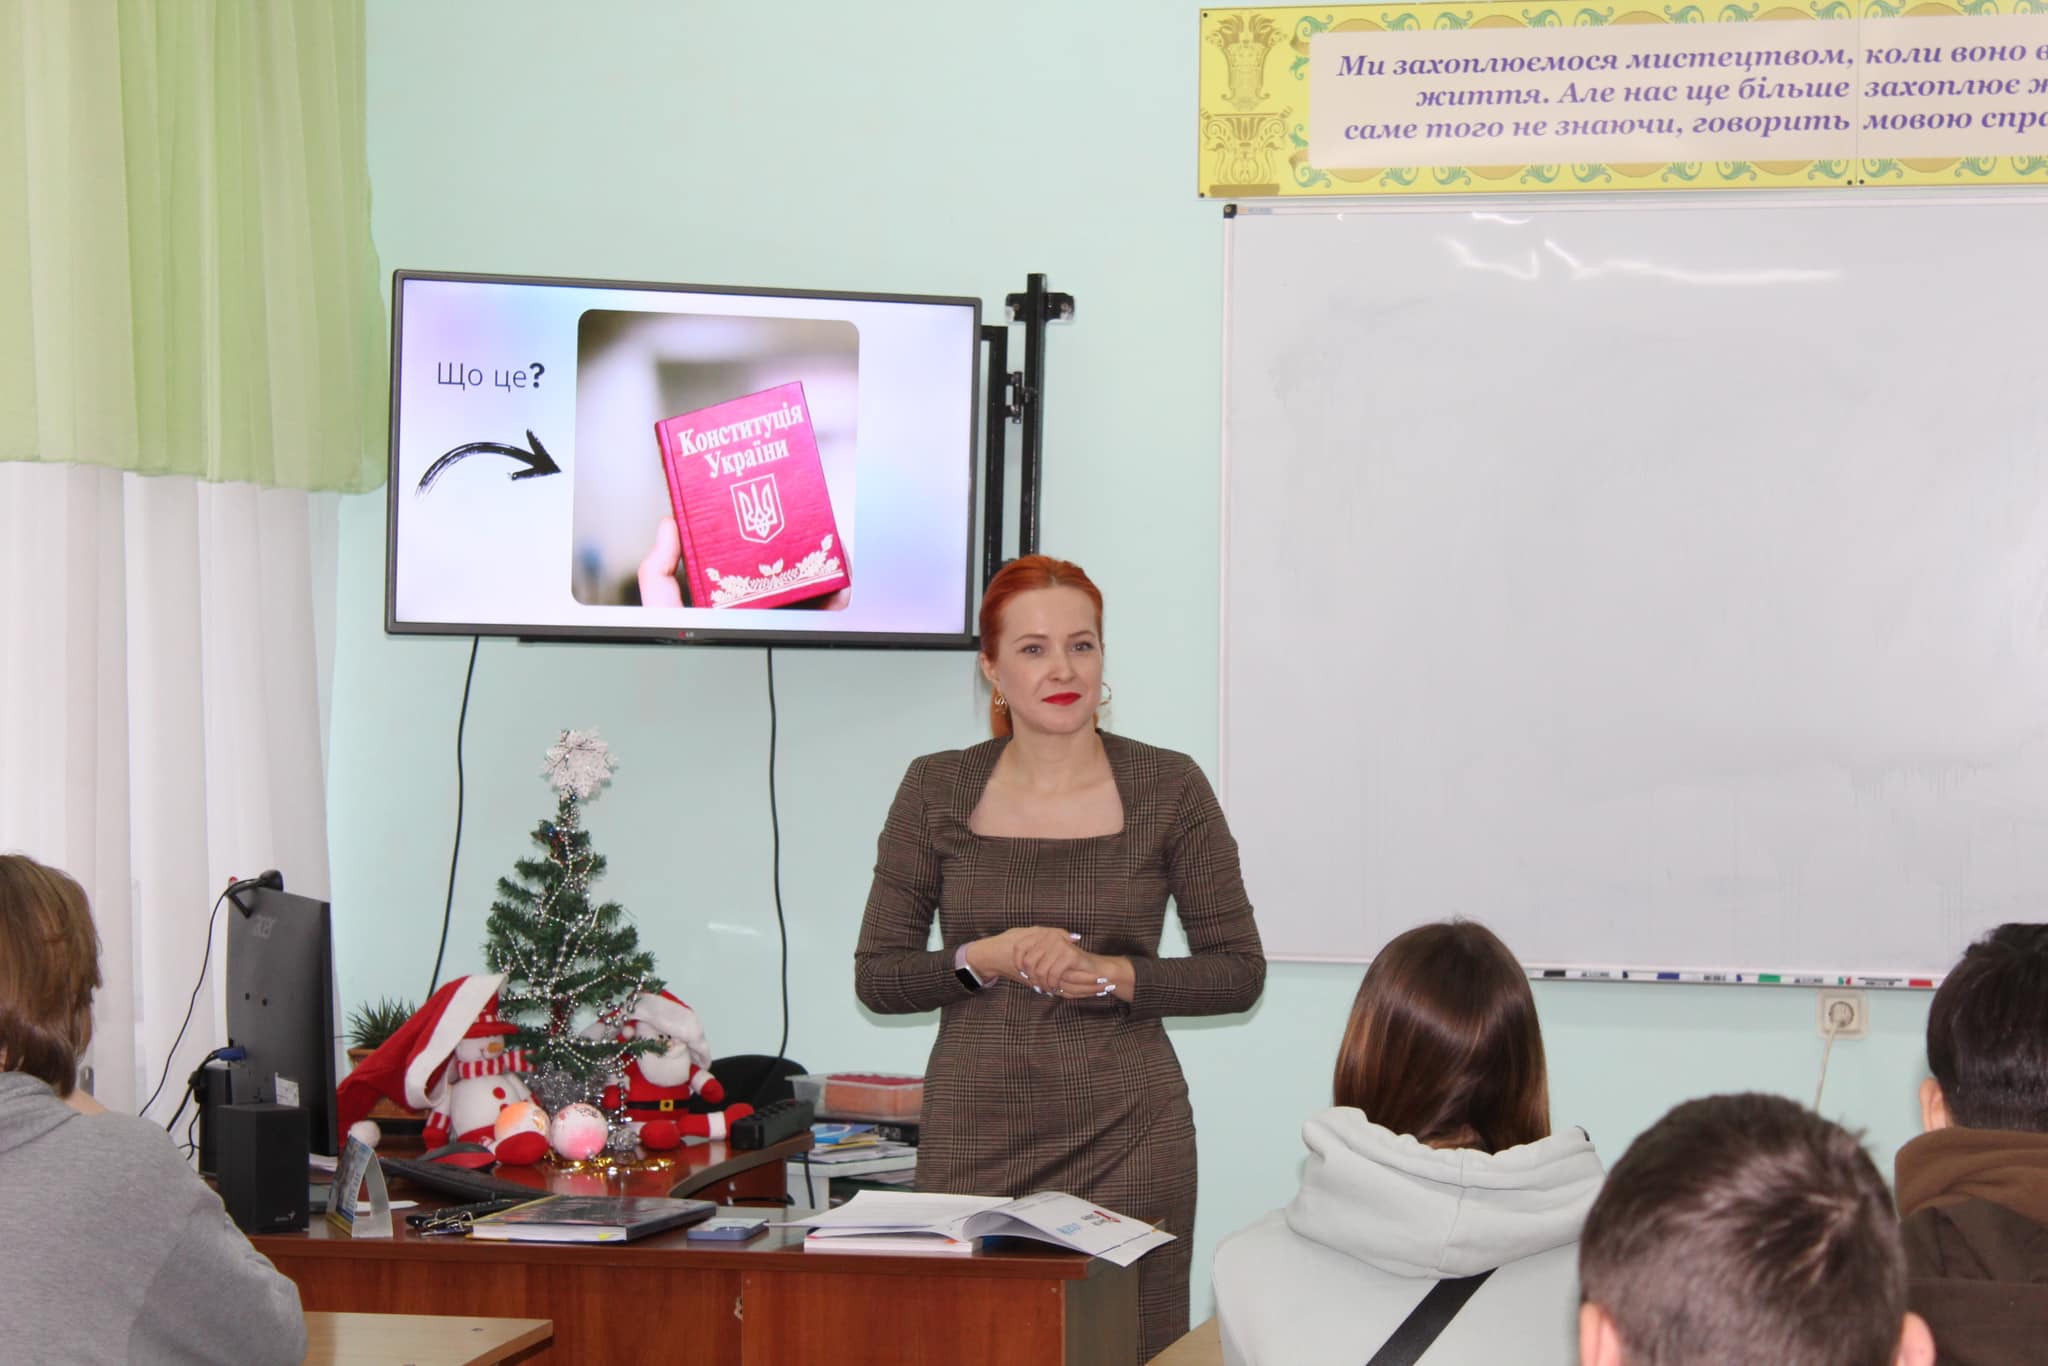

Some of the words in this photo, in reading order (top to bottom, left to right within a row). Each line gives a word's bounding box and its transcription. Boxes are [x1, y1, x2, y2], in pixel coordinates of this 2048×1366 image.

[1337, 55, 1385, 77] Ми
[1392, 53, 1619, 76] захоплюємося
[1625, 48, 1854, 73] мистецтвом,
[1865, 47, 1943, 65] коли
[1950, 44, 2028, 63] воно
[1415, 87, 1550, 107] життя.
[1558, 82, 1616, 104] Але
[1623, 85, 1679, 102] нас
[1686, 84, 1731, 107] ще
[1737, 75, 1851, 100] більше
[1863, 78, 2022, 98] захоплює
[1344, 122, 1418, 140] саме
[1425, 121, 1505, 139] того
[1512, 119, 1549, 137] не
[1554, 116, 1684, 137] знаючи,
[1691, 114, 1851, 138] говорить
[1862, 111, 1974, 131] мовою
[438, 361, 483, 392] Що
[495, 362, 545, 393] це?
[677, 401, 804, 457] Конституція
[703, 439, 790, 479] України
